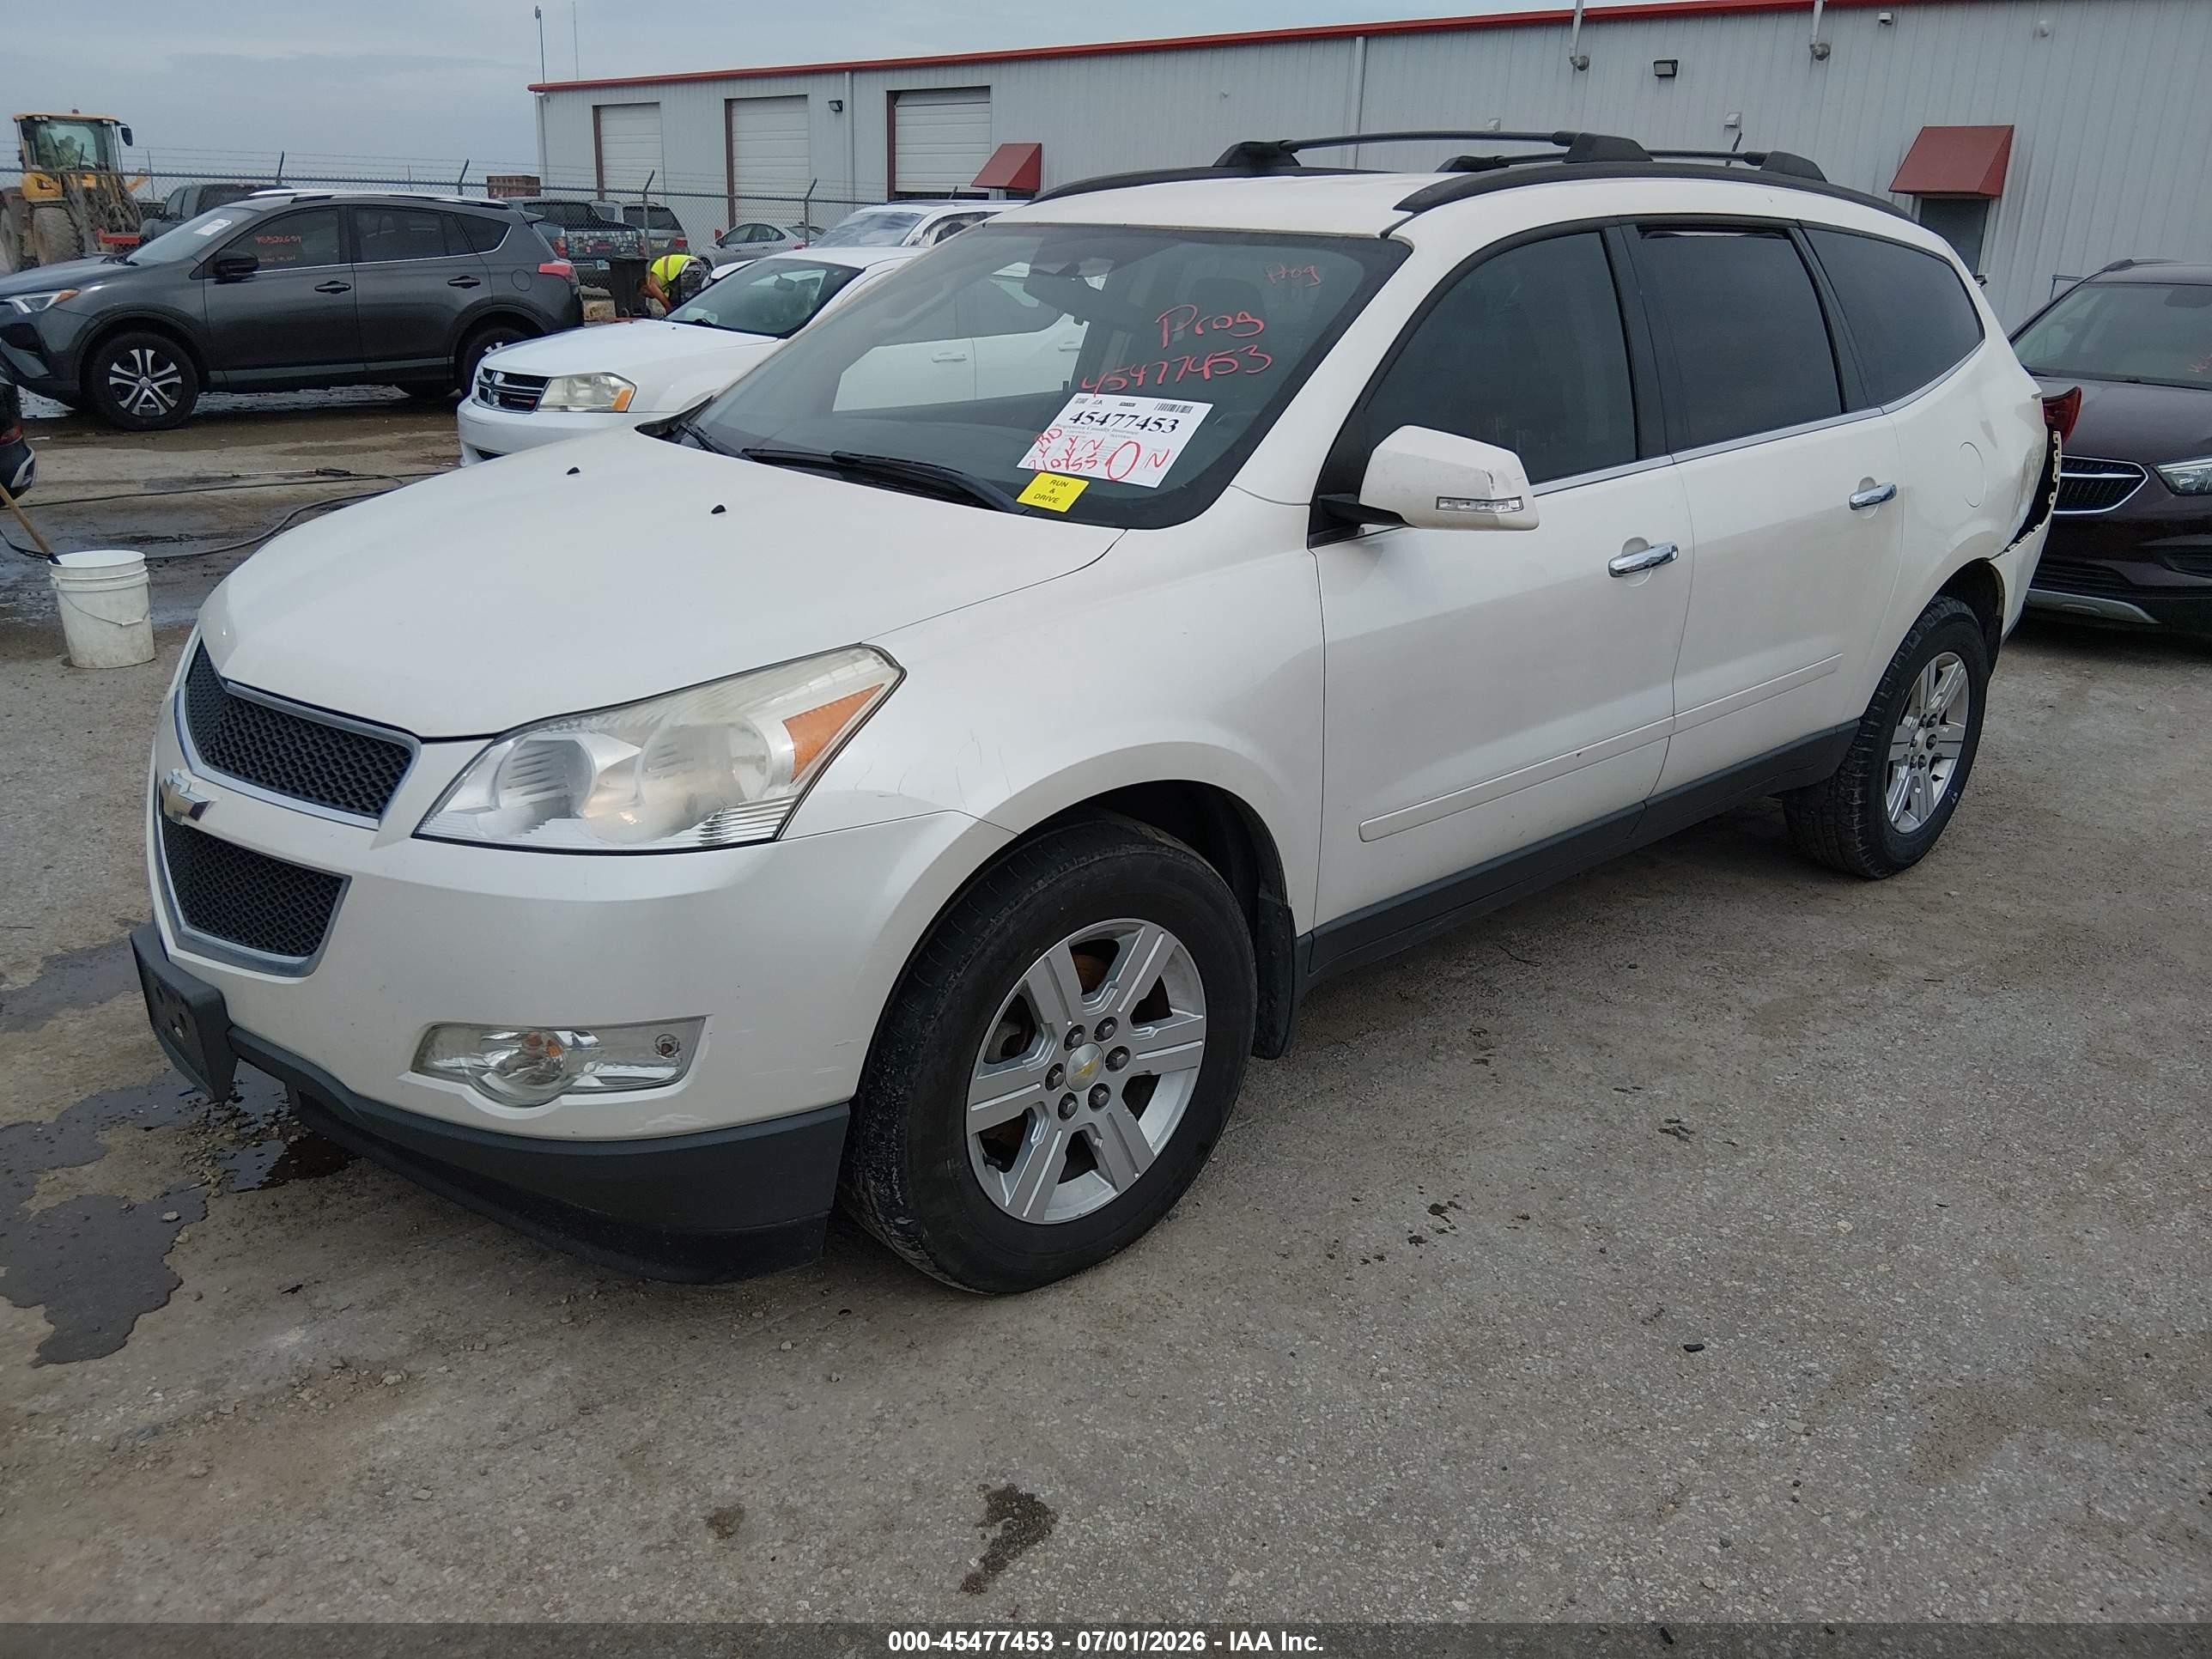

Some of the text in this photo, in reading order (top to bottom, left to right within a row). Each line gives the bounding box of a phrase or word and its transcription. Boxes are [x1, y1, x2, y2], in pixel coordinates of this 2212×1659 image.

[1156, 304, 1265, 349] Prog
[1080, 344, 1273, 398] 45477453
[1069, 410, 1180, 434] 45477453
[1049, 479, 1069, 488] RUN
[1034, 494, 1060, 503] DRIVE
